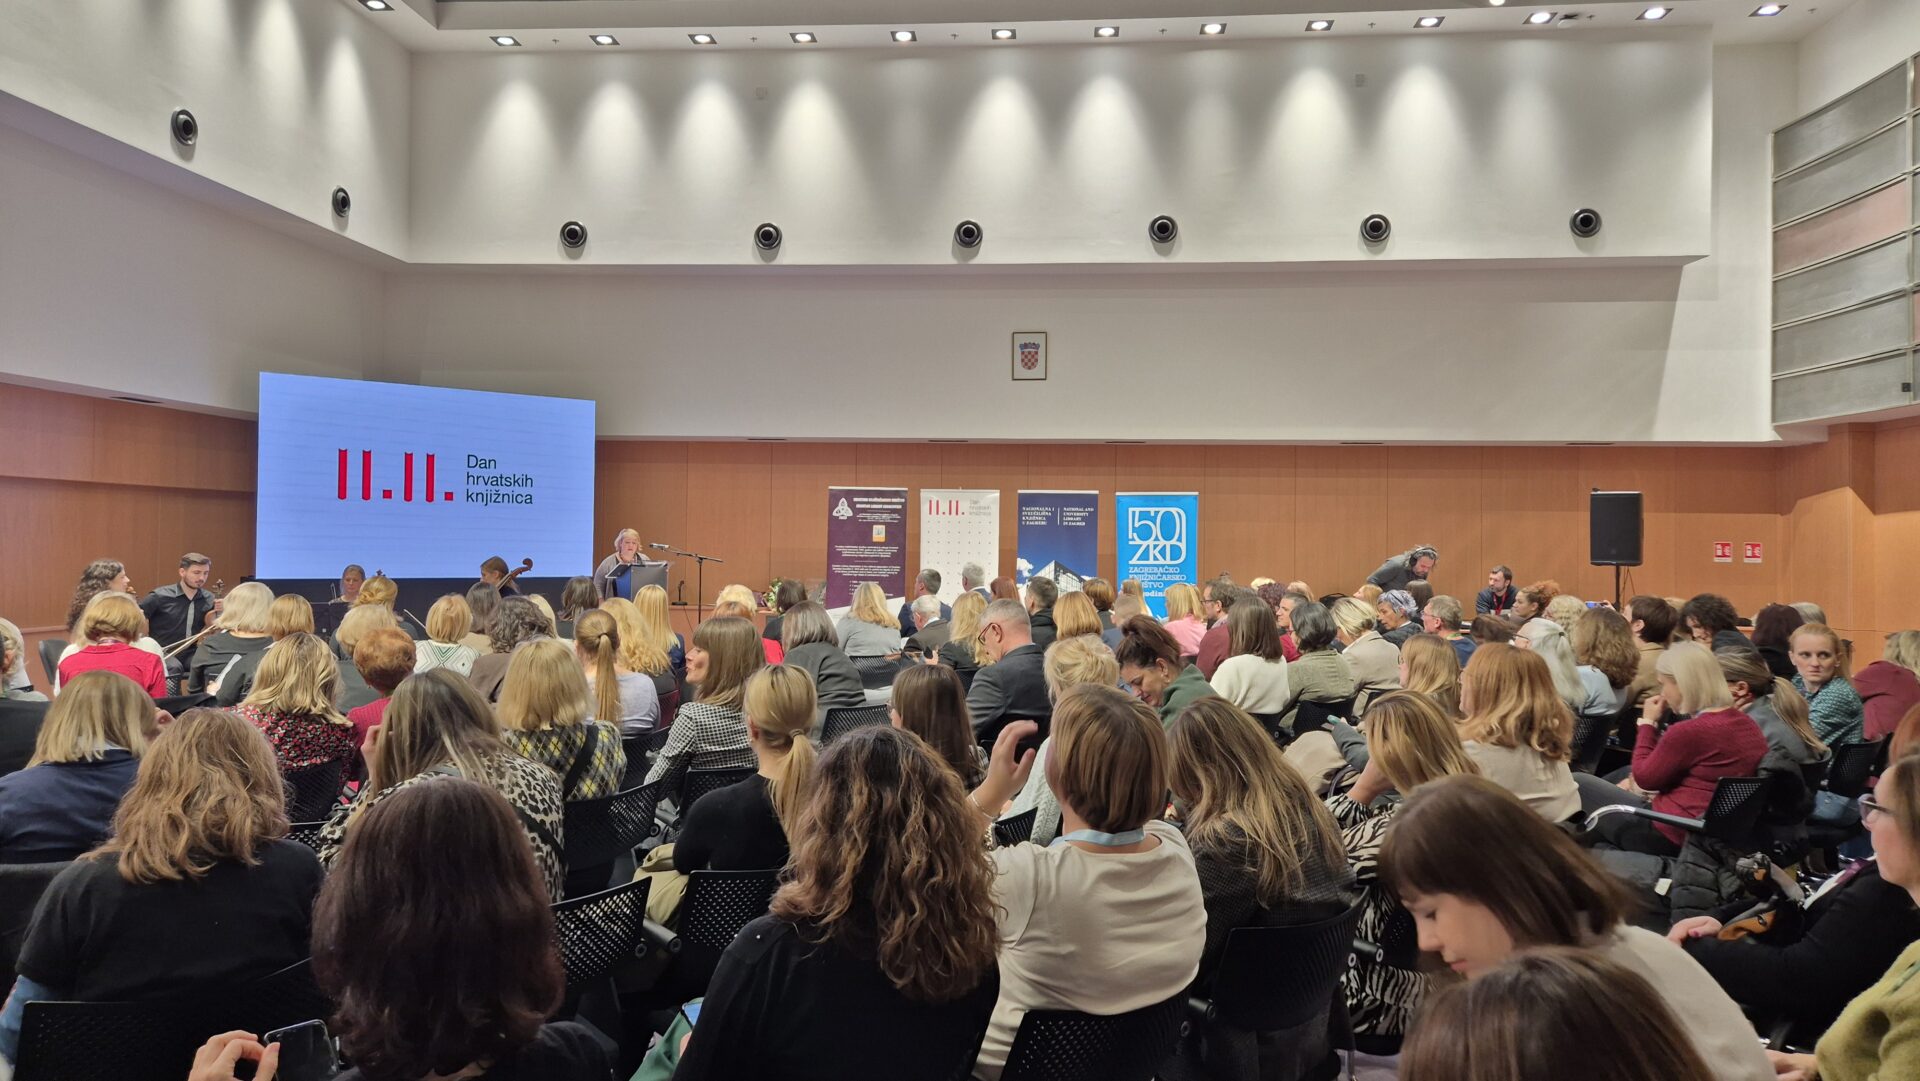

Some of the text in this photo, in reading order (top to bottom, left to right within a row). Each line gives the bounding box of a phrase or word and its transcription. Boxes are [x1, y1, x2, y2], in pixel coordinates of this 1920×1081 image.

[466, 454, 497, 469] Dan
[466, 471, 533, 488] hrvatskih
[466, 488, 533, 506] knjižnica
[1132, 508, 1181, 543] 50
[1128, 540, 1187, 564] ZKD
